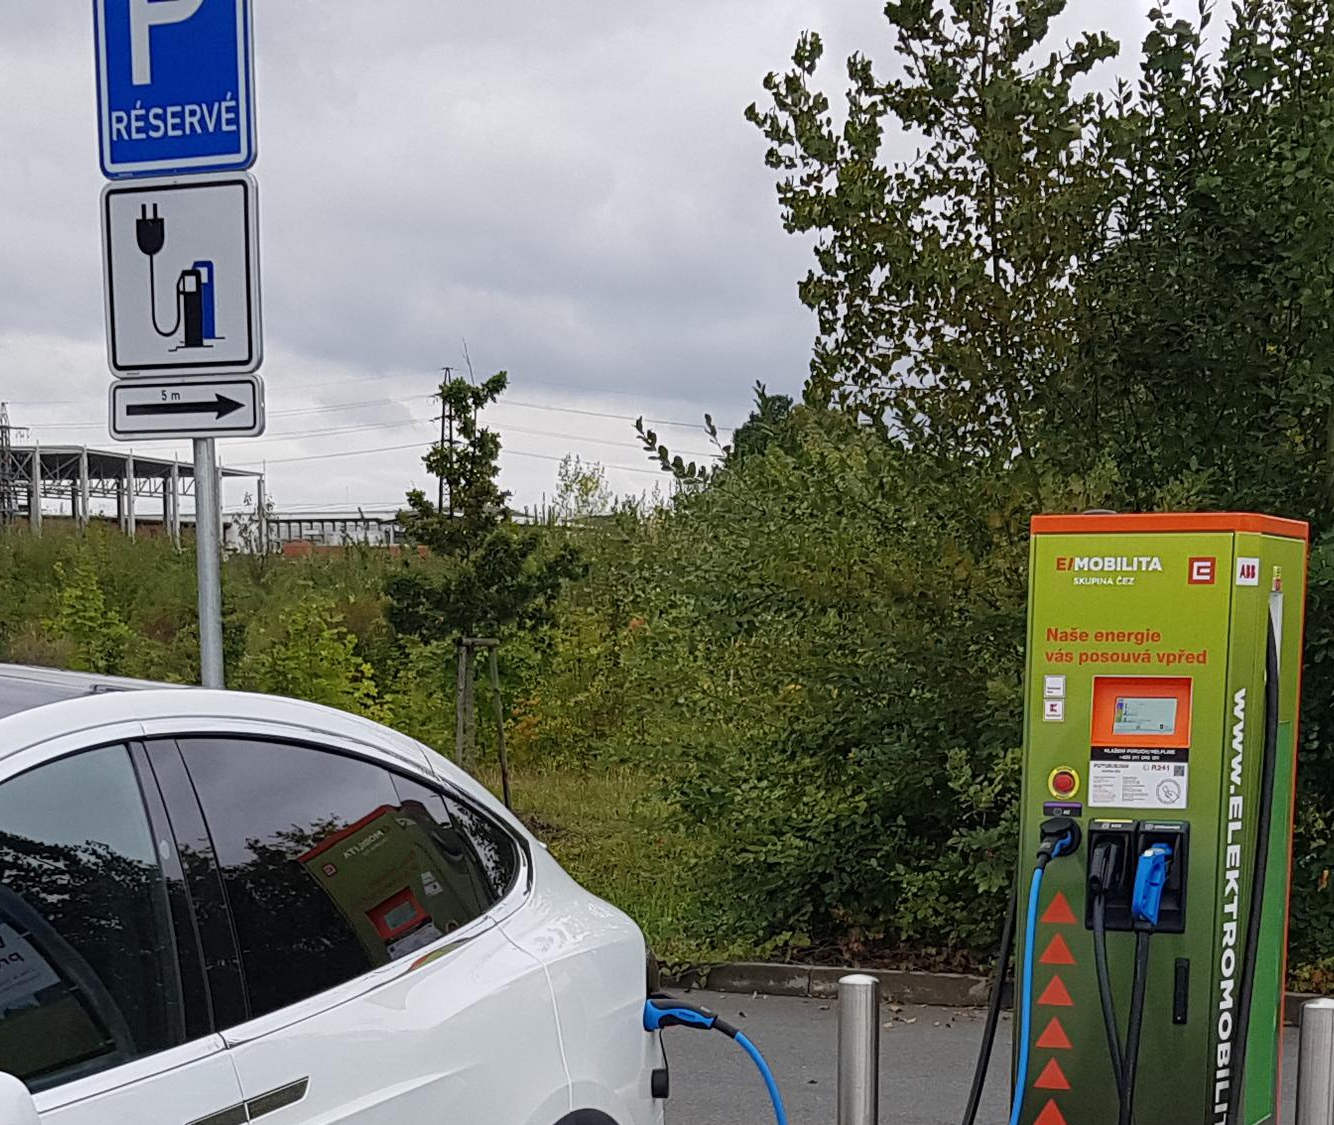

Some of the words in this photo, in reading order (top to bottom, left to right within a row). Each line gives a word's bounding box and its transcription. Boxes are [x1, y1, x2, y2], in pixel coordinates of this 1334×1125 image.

[111, 91, 238, 141] RÉSERVÉ
[161, 390, 167, 401] 5
[171, 392, 181, 401] m
[1073, 577, 1114, 585] SKUPINA
[1116, 576, 1135, 585] ČEZ
[1046, 628, 1089, 642] Naše
[1094, 629, 1162, 645] energie
[1045, 651, 1074, 663] vás
[1078, 651, 1151, 665] posouvá
[1156, 650, 1207, 666] vpřed
